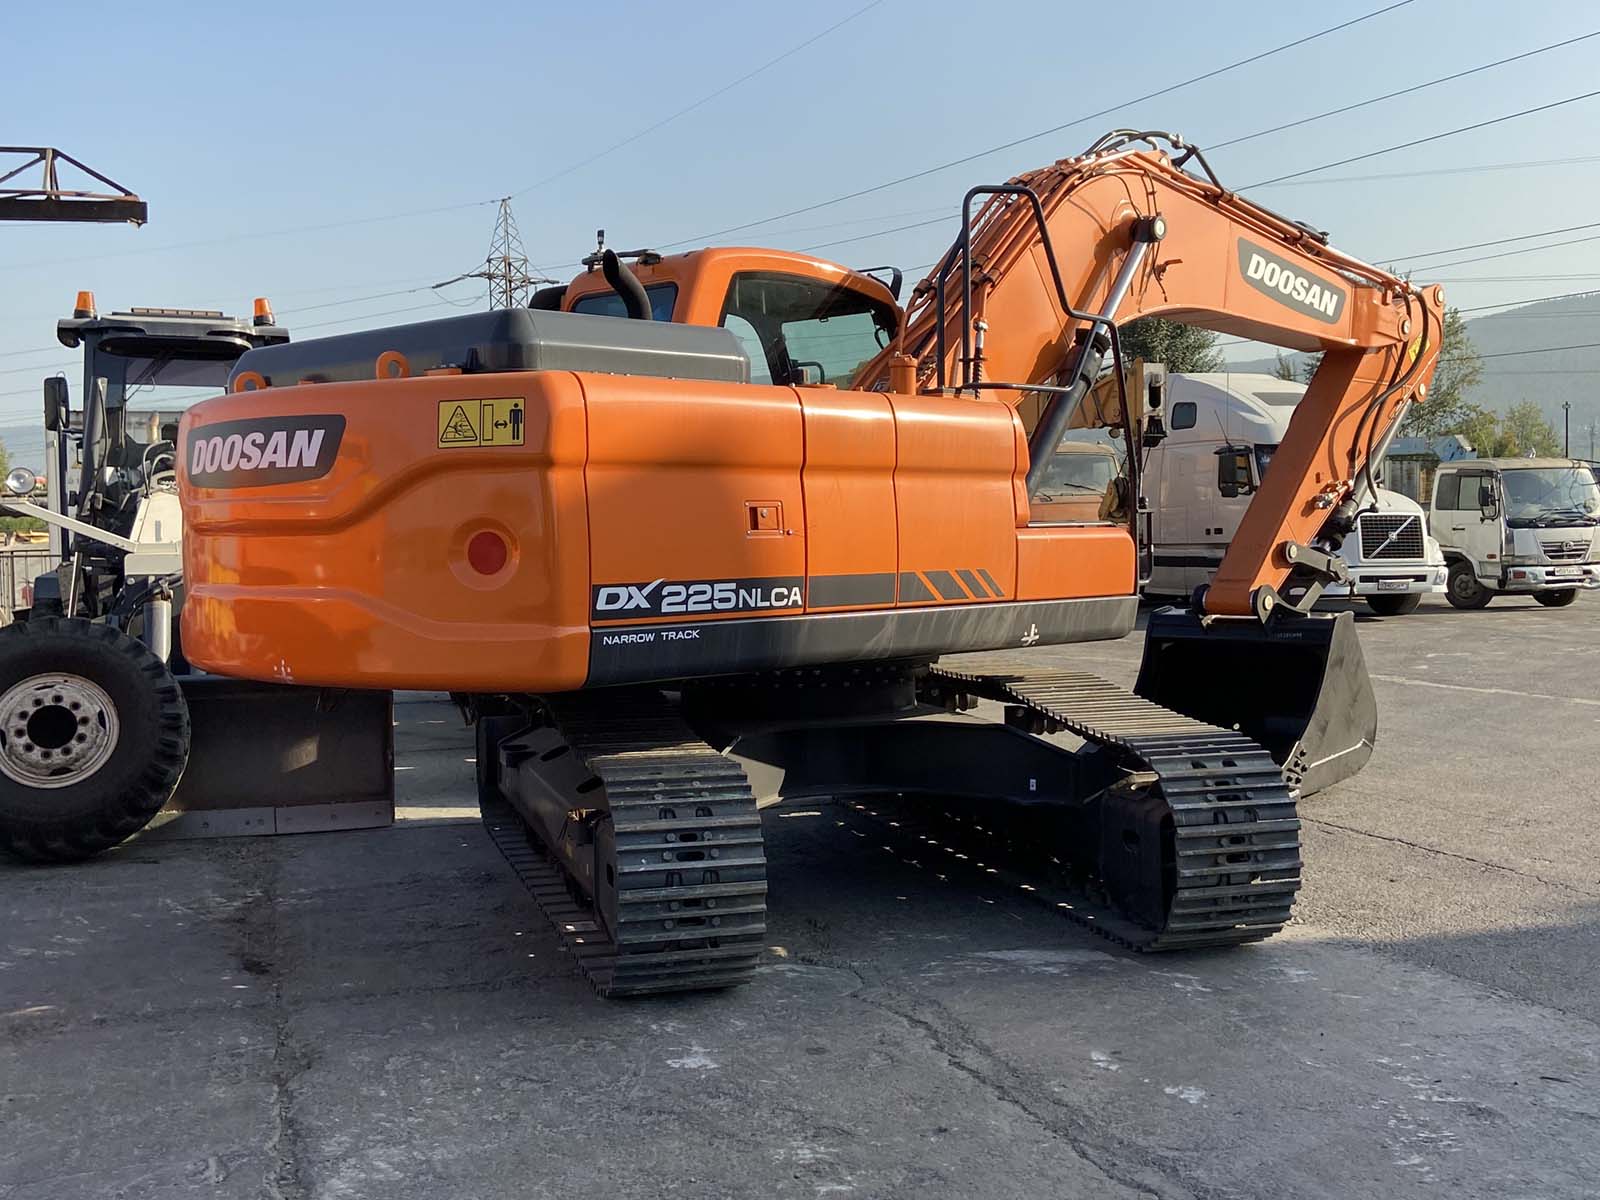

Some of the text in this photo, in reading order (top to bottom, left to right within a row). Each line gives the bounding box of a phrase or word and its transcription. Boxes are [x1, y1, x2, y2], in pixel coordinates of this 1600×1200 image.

[1247, 253, 1338, 316] DOOSAN
[191, 429, 325, 475] DOOSAN
[603, 630, 700, 645] NARROW TRACK
